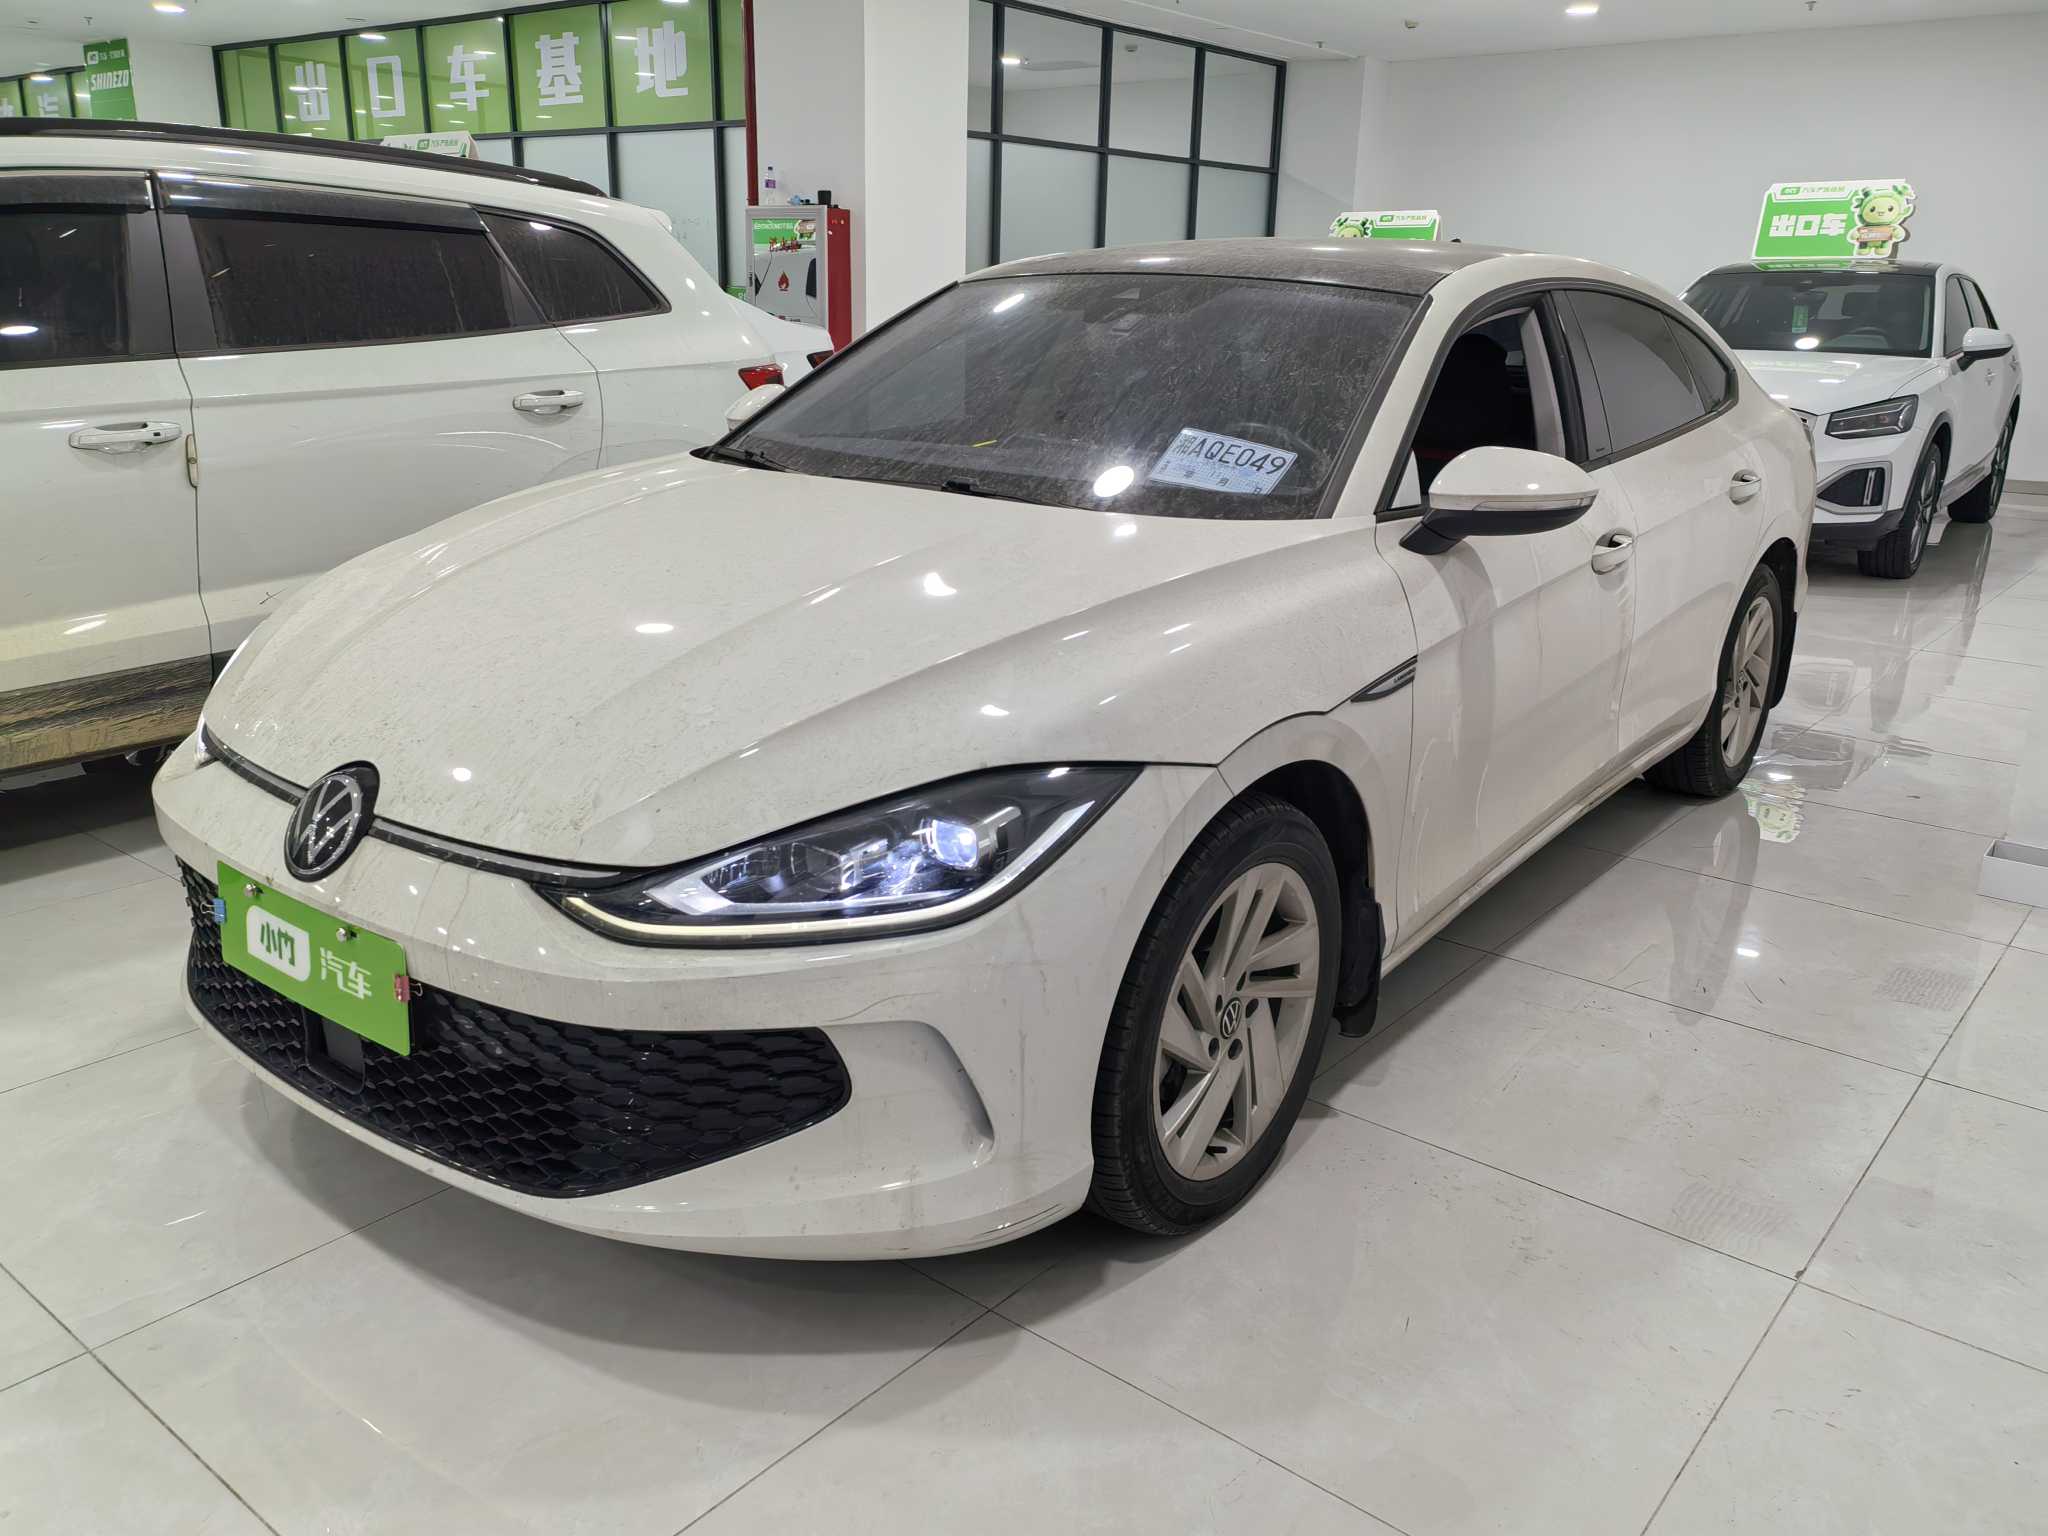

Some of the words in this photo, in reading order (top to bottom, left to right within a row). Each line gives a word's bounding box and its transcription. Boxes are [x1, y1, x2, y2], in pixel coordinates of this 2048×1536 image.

[1770, 214, 1847, 237] 出口车
[319, 946, 373, 1000] 汽车
